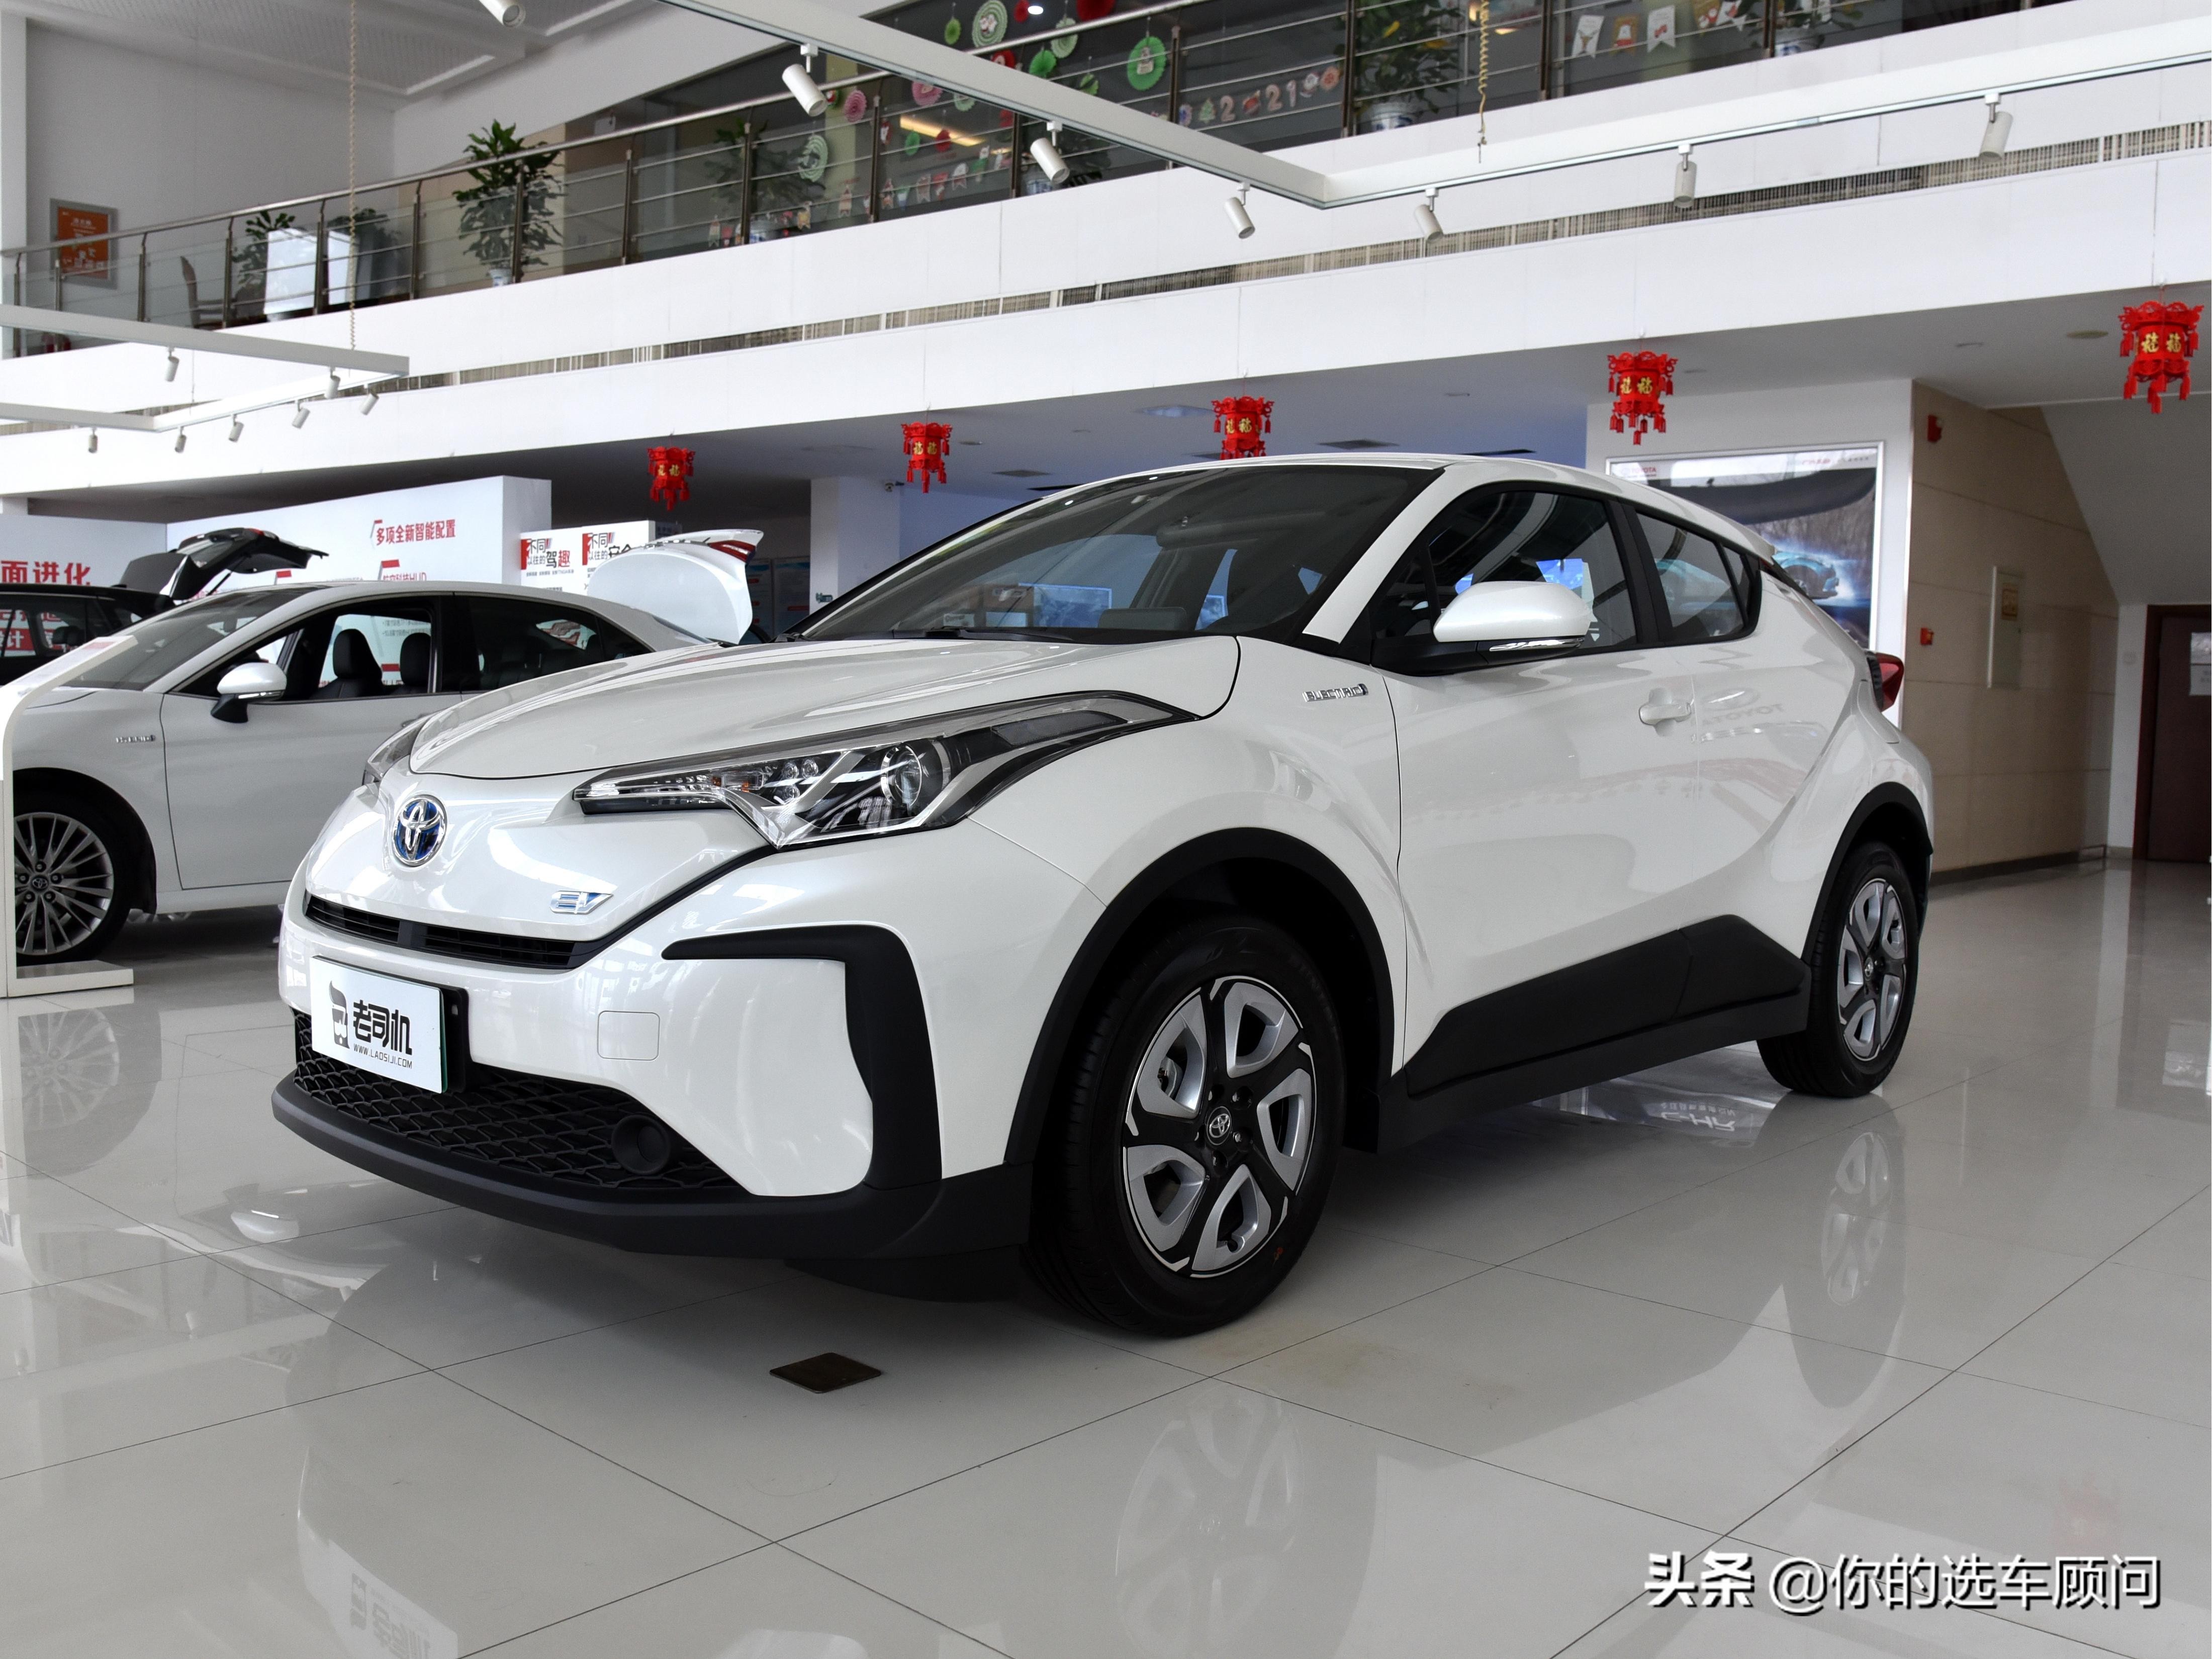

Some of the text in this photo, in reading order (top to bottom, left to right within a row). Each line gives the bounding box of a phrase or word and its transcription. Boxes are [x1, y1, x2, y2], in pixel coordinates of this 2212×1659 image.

[377, 519, 455, 545] 多项全新智能配置
[353, 999, 413, 1055] 老司机
[353, 1043, 413, 1069] WWW.LAOSIJI.COM
